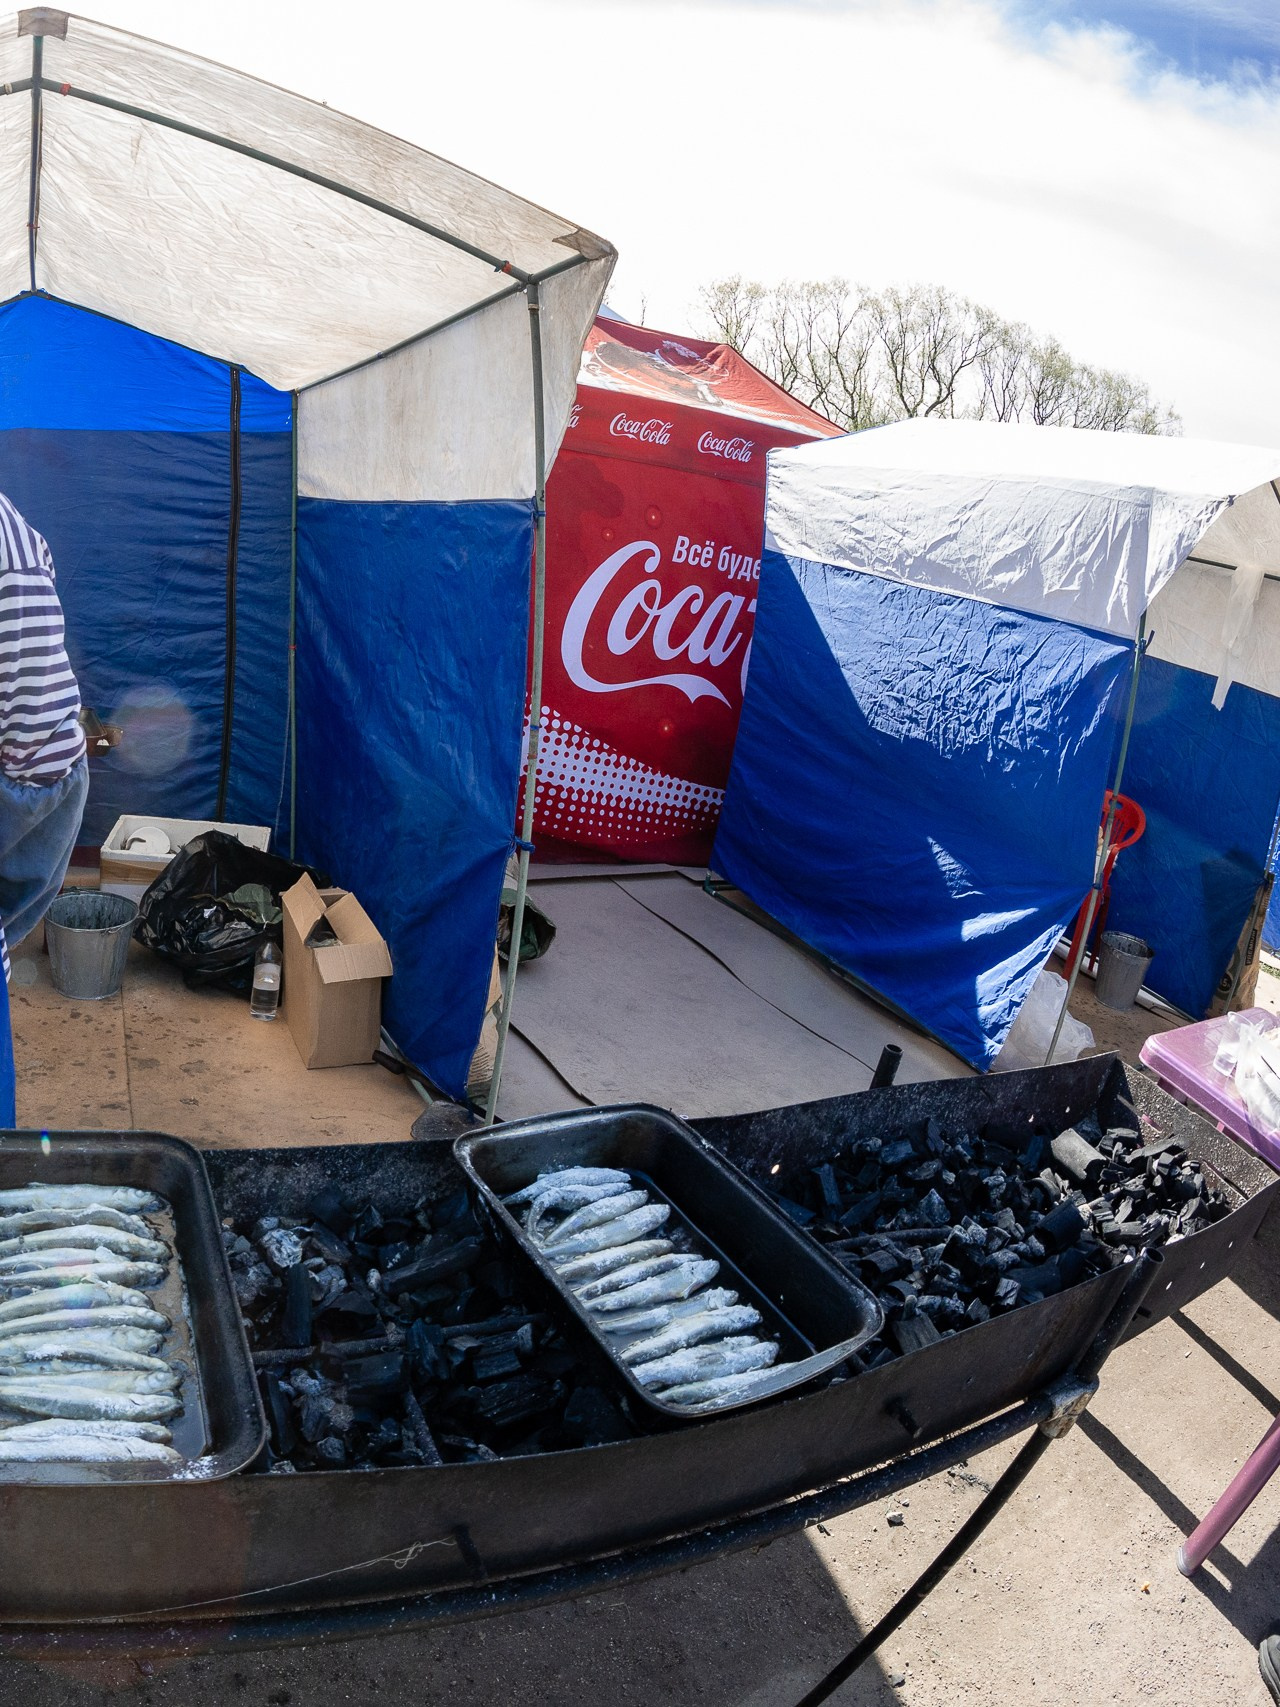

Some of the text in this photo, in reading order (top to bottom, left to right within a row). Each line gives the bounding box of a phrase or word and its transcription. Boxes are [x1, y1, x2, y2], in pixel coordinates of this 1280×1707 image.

[609, 412, 674, 446] Coca-Cola
[697, 430, 755, 463] Coca-Cola
[672, 535, 715, 568] Всё
[561, 540, 758, 710] Coca-
